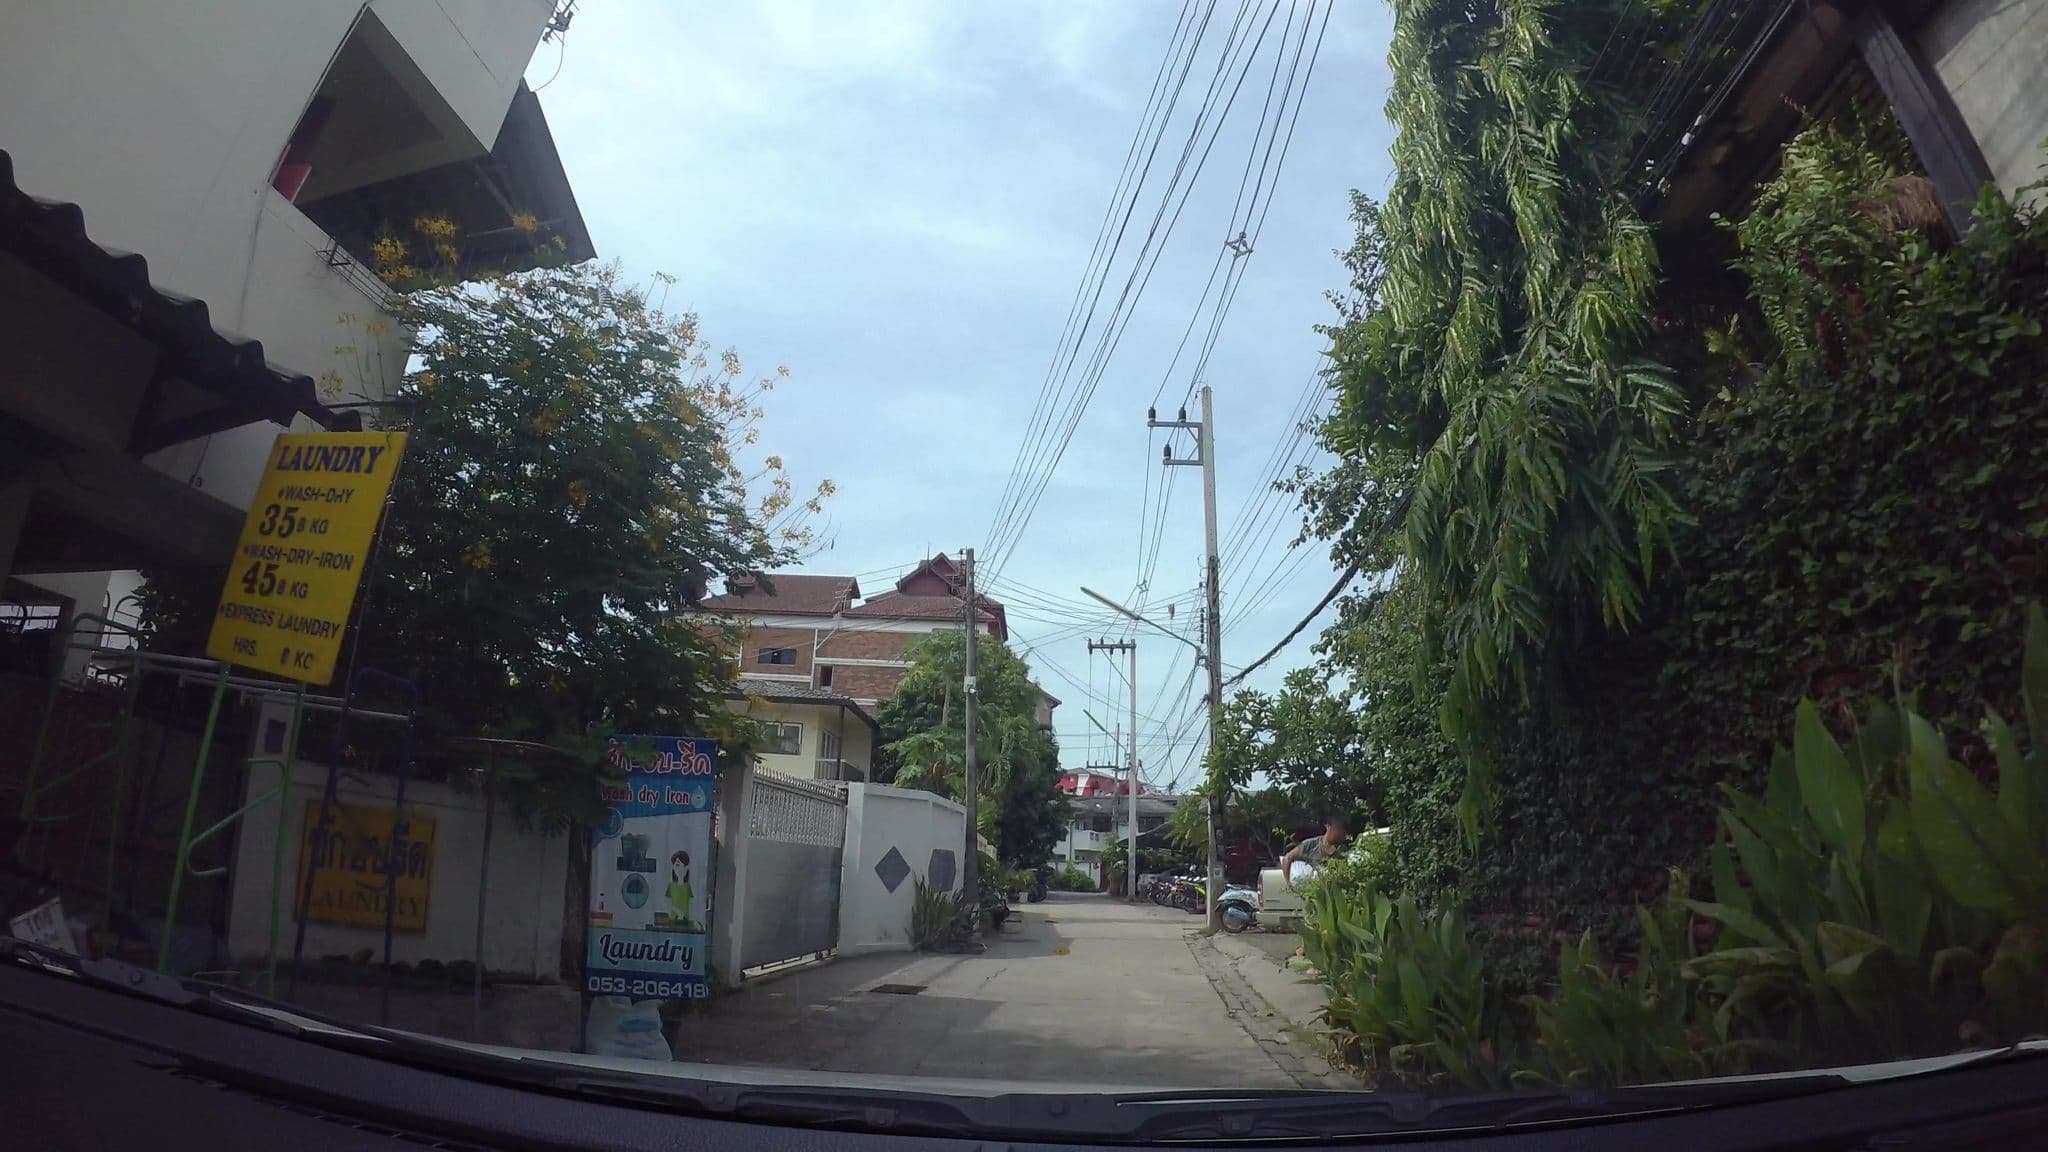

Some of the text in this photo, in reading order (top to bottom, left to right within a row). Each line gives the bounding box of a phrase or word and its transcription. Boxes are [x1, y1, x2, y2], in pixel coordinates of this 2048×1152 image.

[276, 446, 385, 474] LAUNDRY
[258, 503, 299, 538] 35
[309, 518, 329, 535] KG
[242, 561, 280, 597] 45
[289, 582, 309, 598] KG
[278, 612, 341, 639] LAUNDRY
[638, 785, 660, 808] dry
[600, 933, 694, 970] Laundry
